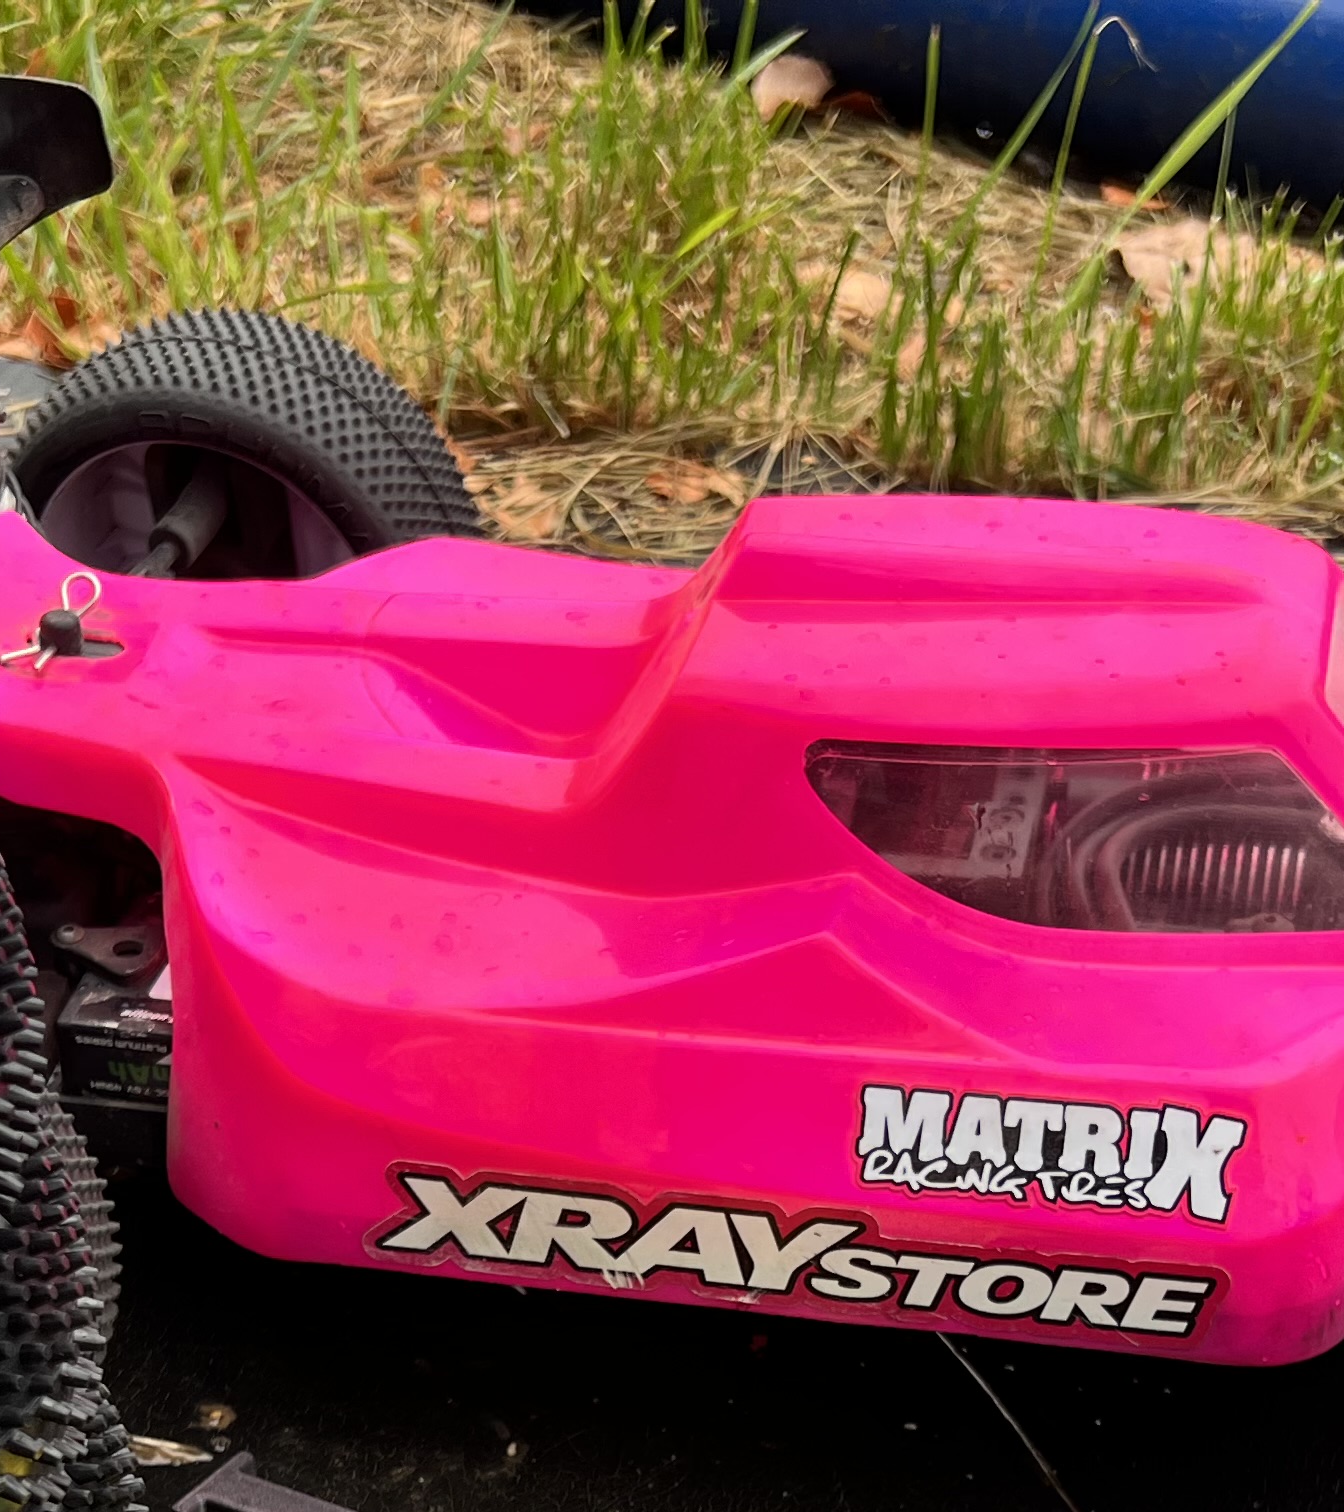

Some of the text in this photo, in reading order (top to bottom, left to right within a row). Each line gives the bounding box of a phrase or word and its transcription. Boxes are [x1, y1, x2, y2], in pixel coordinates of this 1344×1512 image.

[858, 1086, 1246, 1221] MATRIX
[863, 1150, 1028, 1199] RACING
[380, 1176, 1213, 1334] XRAYSTORE
